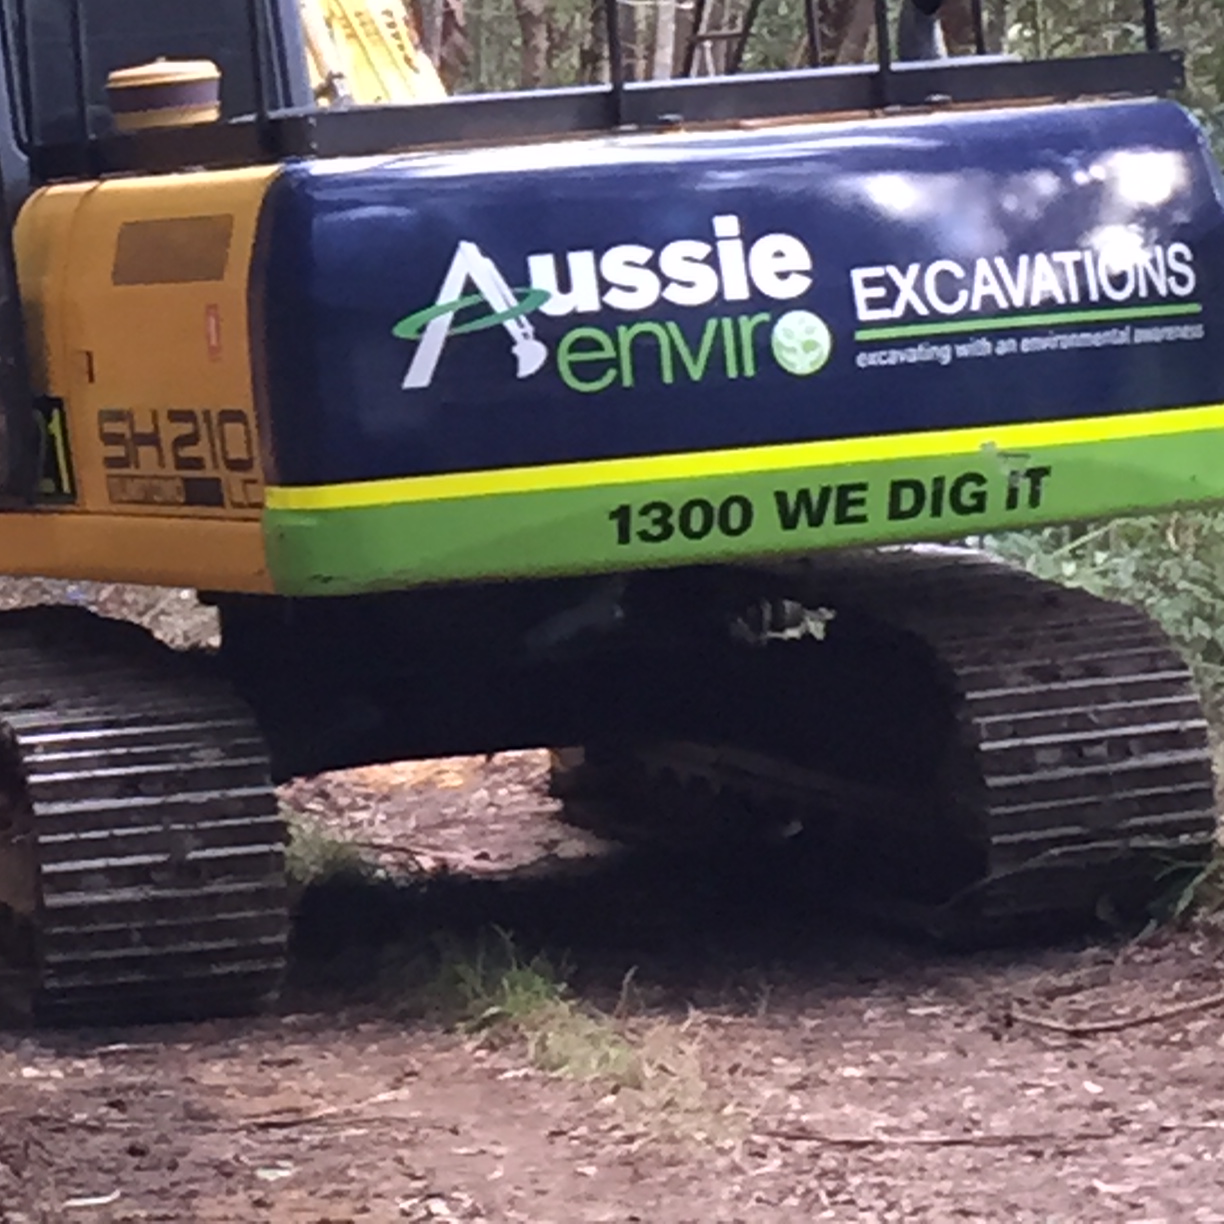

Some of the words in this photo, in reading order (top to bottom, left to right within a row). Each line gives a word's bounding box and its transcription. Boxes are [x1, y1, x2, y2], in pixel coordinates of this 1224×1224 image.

[402, 214, 813, 389] Aussie
[850, 242, 1197, 322] EXCAVATIONS
[855, 342, 952, 368] excavating
[954, 337, 993, 358] with
[995, 337, 1018, 356] an
[97, 408, 255, 471] SH210
[608, 494, 754, 546] 1300
[774, 482, 869, 530] WE
[887, 472, 988, 520] DIG
[1004, 466, 1052, 512] IT
